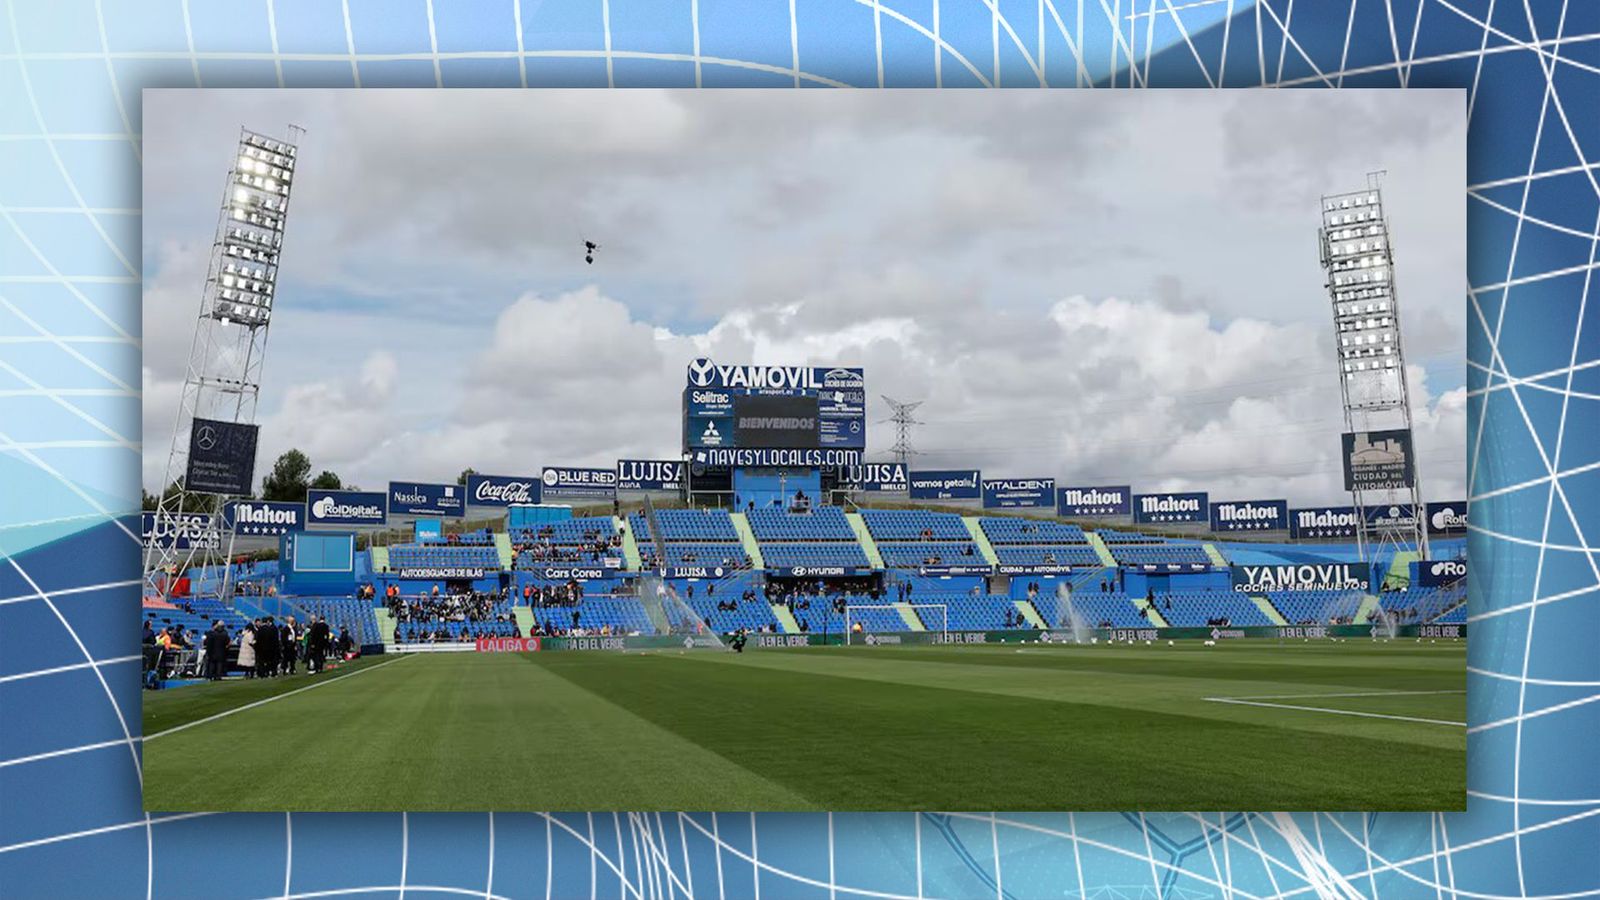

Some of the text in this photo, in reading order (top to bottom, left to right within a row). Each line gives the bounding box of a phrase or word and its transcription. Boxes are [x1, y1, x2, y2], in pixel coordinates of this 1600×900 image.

[717, 366, 823, 388] YAMOVIL
[739, 417, 815, 429] BIENVENIDOS
[559, 471, 616, 483] BLUE RED
[838, 464, 906, 483] LUJISA
[1353, 471, 1388, 481] CIUDAD
[912, 480, 943, 488] vamos
[983, 480, 1054, 490] VITALDENT
[394, 486, 427, 503] Nassica
[1065, 488, 1122, 506] Mahou
[1142, 495, 1199, 513] Mahou
[233, 503, 297, 525] Mahou
[1218, 503, 1278, 521] Mahou
[1298, 509, 1361, 528] Mahou
[545, 568, 602, 578] Cars Corea
[675, 567, 707, 577] LUJISA
[808, 567, 845, 575] HYUNDAI
[1243, 565, 1358, 585] YAMOVIL
[1234, 581, 1368, 593] COCHES SEMINUEVOS
[480, 640, 523, 651] LALIGA
